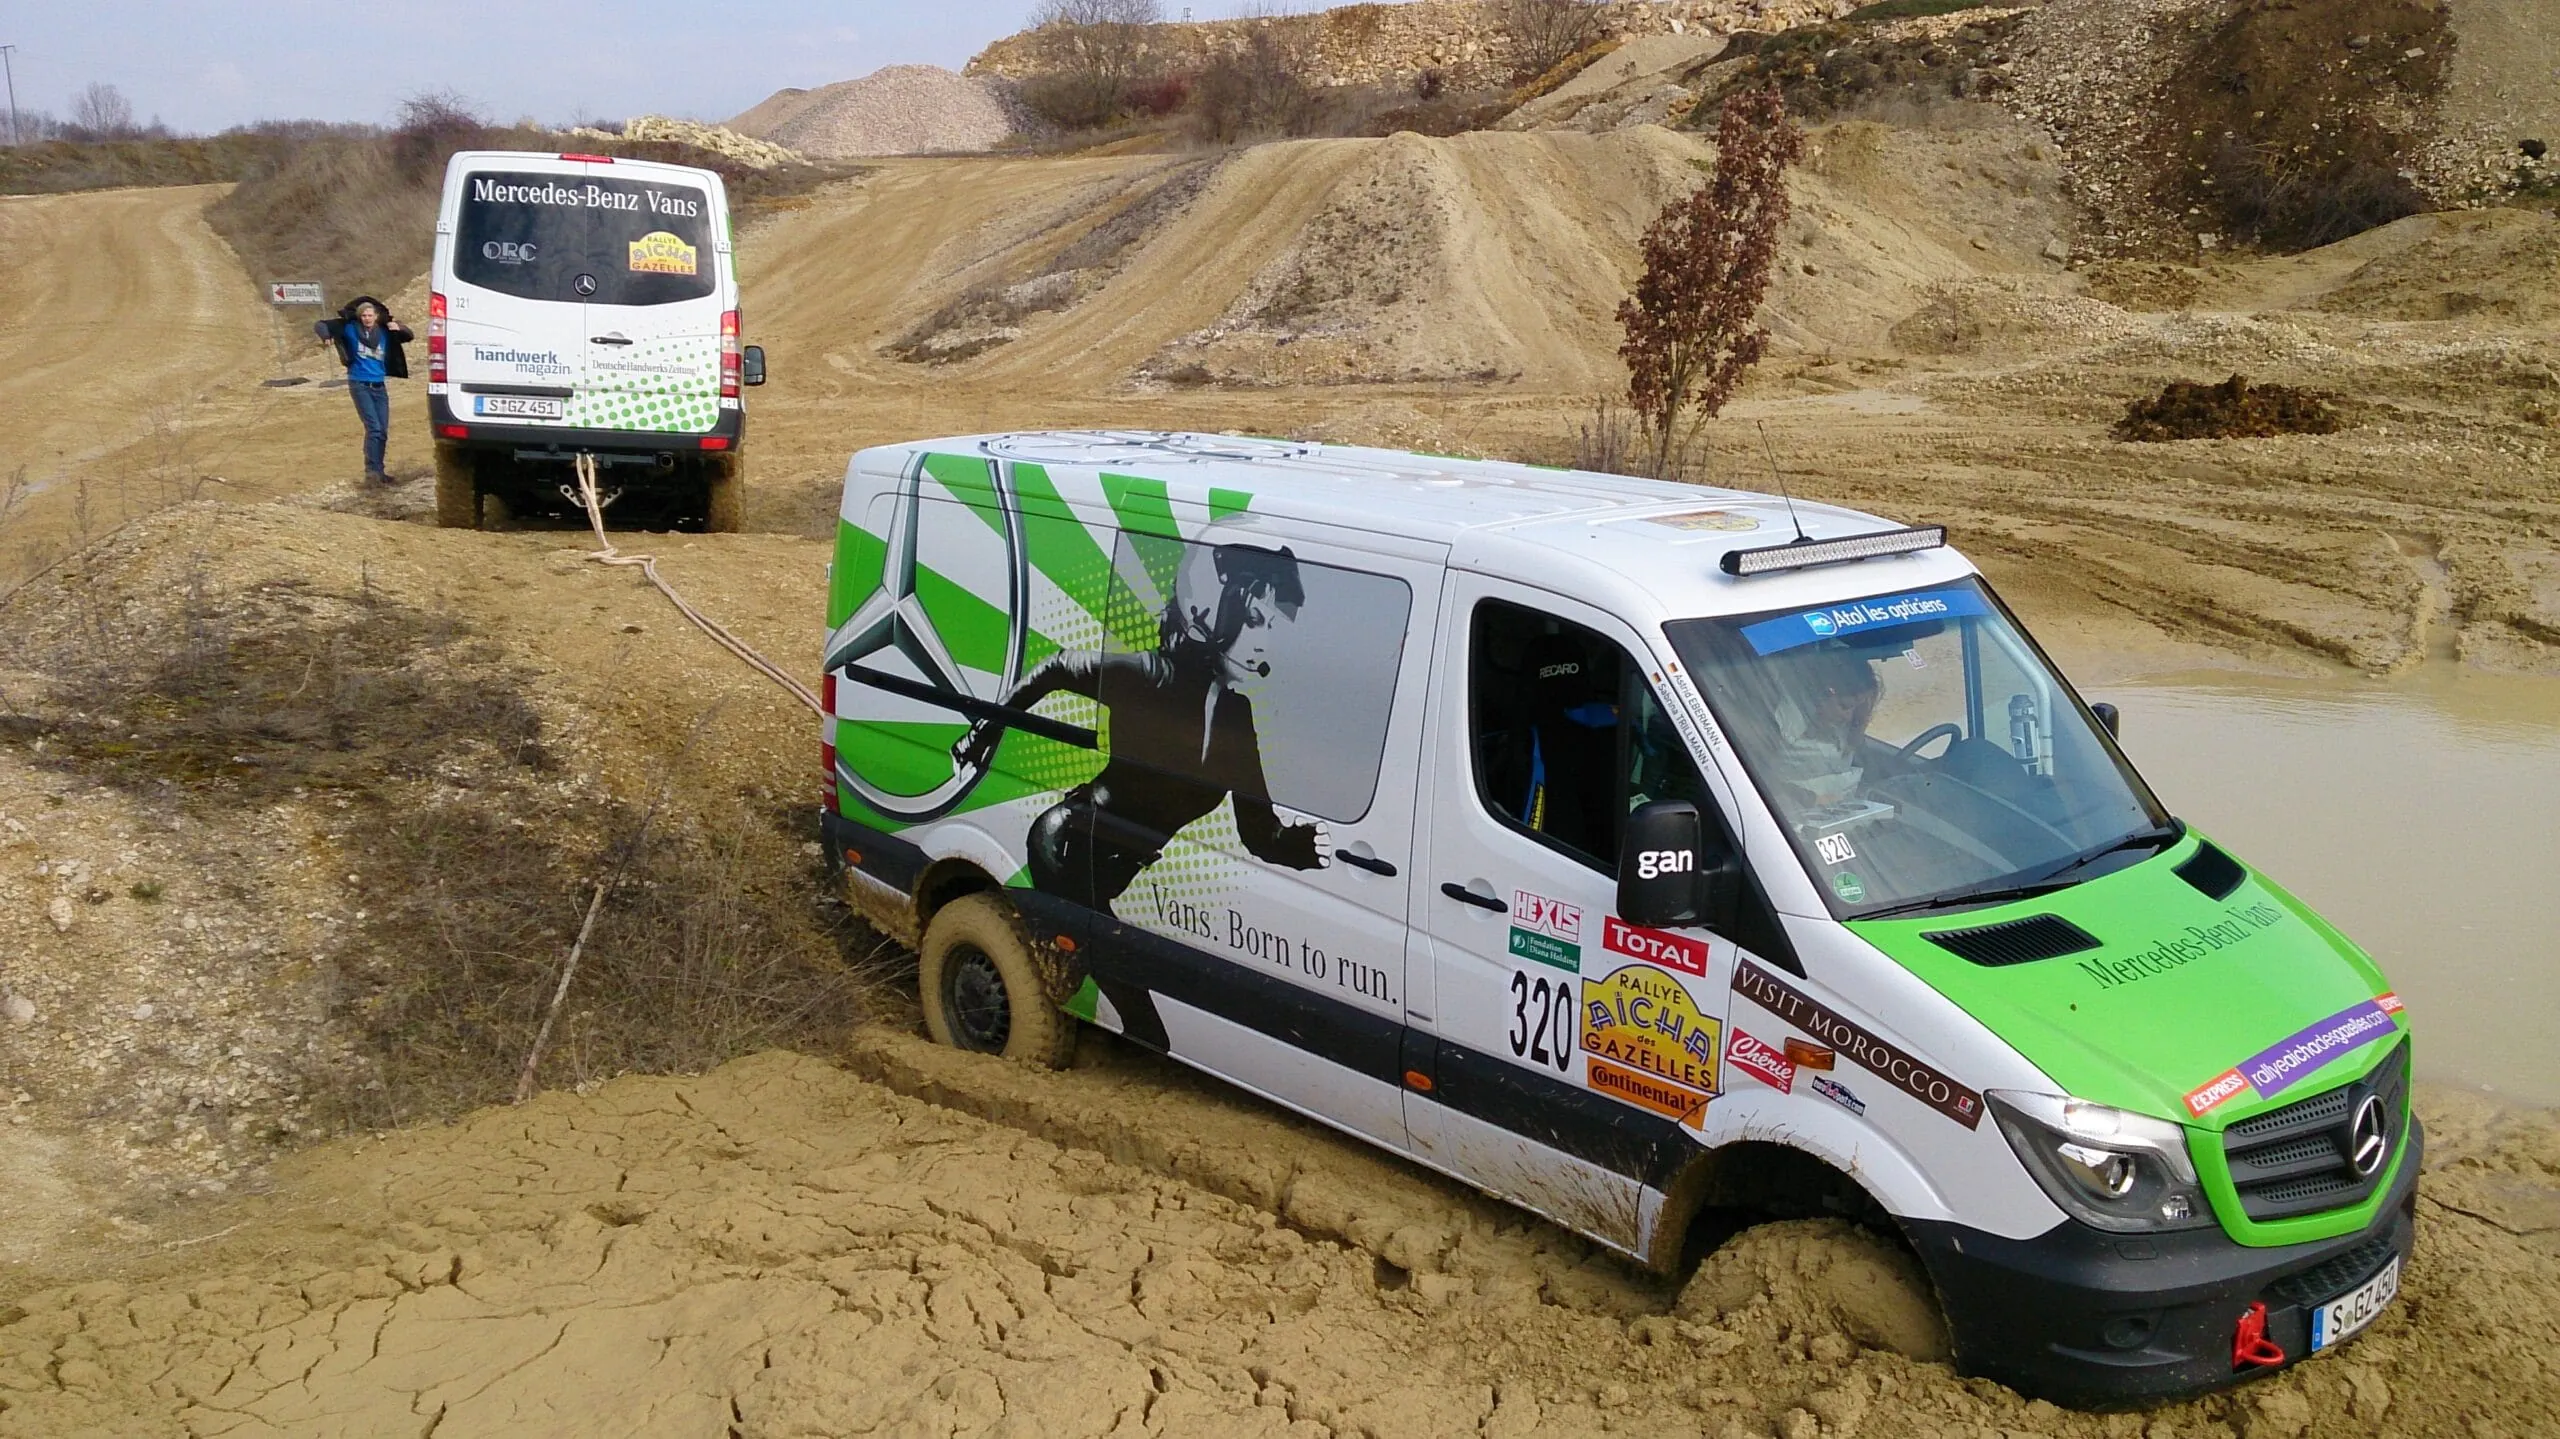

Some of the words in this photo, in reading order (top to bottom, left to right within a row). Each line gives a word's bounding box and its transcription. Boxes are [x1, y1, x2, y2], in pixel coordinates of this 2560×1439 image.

[473, 179, 639, 211] Mercedes-Benz
[645, 189, 698, 217] Vans
[483, 241, 537, 261] ORC
[648, 236, 676, 244] RALLYE
[632, 262, 694, 273] GAZELLES
[475, 347, 558, 364] handwerk
[515, 362, 571, 376] magazin
[592, 360, 626, 371] Deutsche
[627, 362, 667, 373] Handwerks
[668, 364, 696, 376] Zeitung
[529, 401, 555, 415] 451
[1832, 605, 1867, 629] Atol
[1862, 604, 1889, 621] les
[1889, 598, 1948, 620] opticiens
[1539, 662, 1580, 679] RECARO
[1658, 683, 1678, 715] Sabrina
[1676, 713, 1708, 765] TRILLMANN
[1674, 674, 1692, 698] Astrid
[1688, 698, 1722, 746] EBERMANN
[1638, 849, 1693, 879] gan
[1819, 835, 1851, 862] 320
[1513, 890, 1580, 943] HEXIS
[1151, 883, 1218, 941] Vans.
[1227, 909, 1291, 968] Born
[1301, 937, 1326, 979] to
[1337, 957, 1398, 1004] run.
[1530, 936, 1562, 952] Fondation
[1550, 951, 1578, 968] Holding
[1611, 923, 1699, 970] TOTAL
[2076, 920, 2251, 989] Mercedes-Benz
[2225, 901, 2282, 930] Vans
[1619, 973, 1682, 1005] RALLYE
[1509, 970, 1572, 1072] 320
[1741, 966, 1804, 1017] VISIT
[1808, 1010, 1950, 1103] MOROCCO
[1637, 1034, 1656, 1047] des
[2251, 1009, 2389, 1087] rallyeaichadesgazelles.com
[1585, 1032, 1713, 1088] GAZELLES
[1591, 1064, 1686, 1112] Continental
[2192, 1073, 2246, 1111] L'EXPRESS
[2375, 1265, 2395, 1305] 450
